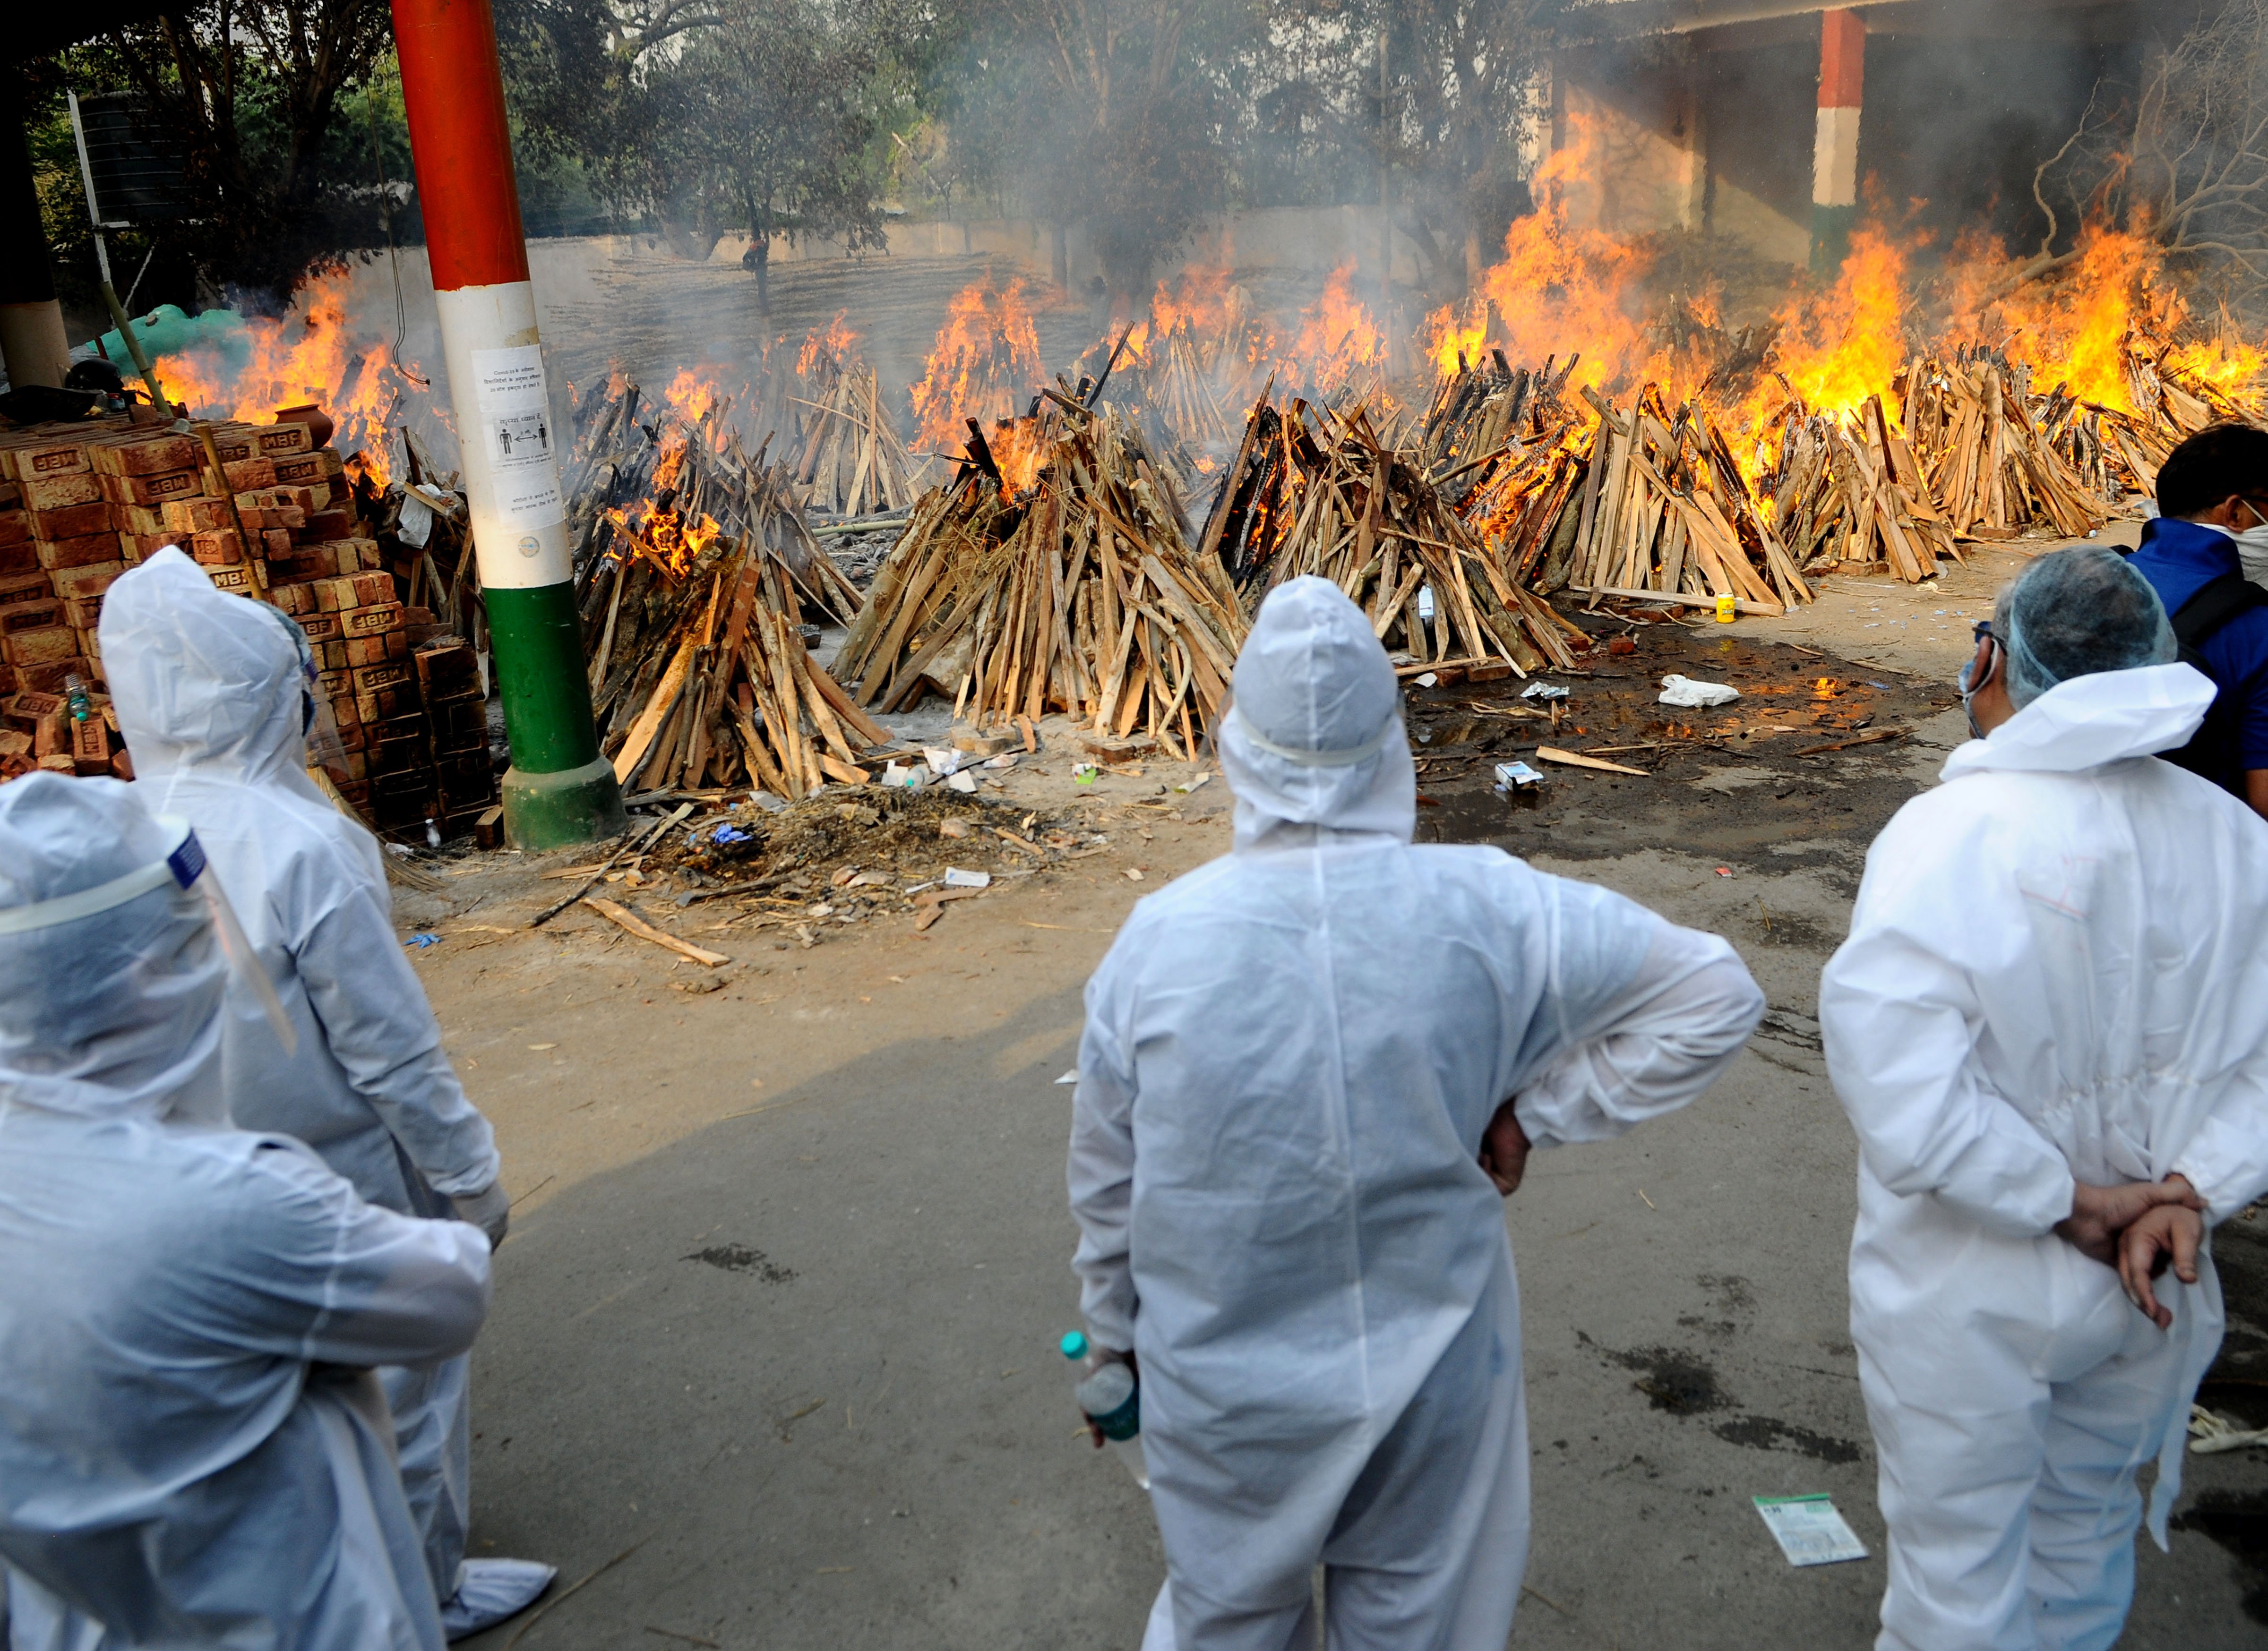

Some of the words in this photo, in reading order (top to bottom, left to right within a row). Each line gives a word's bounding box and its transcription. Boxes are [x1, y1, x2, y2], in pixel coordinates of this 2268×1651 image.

[265, 432, 299, 448] MBF
[150, 476, 186, 493] MBF
[356, 613, 391, 628] MBF
